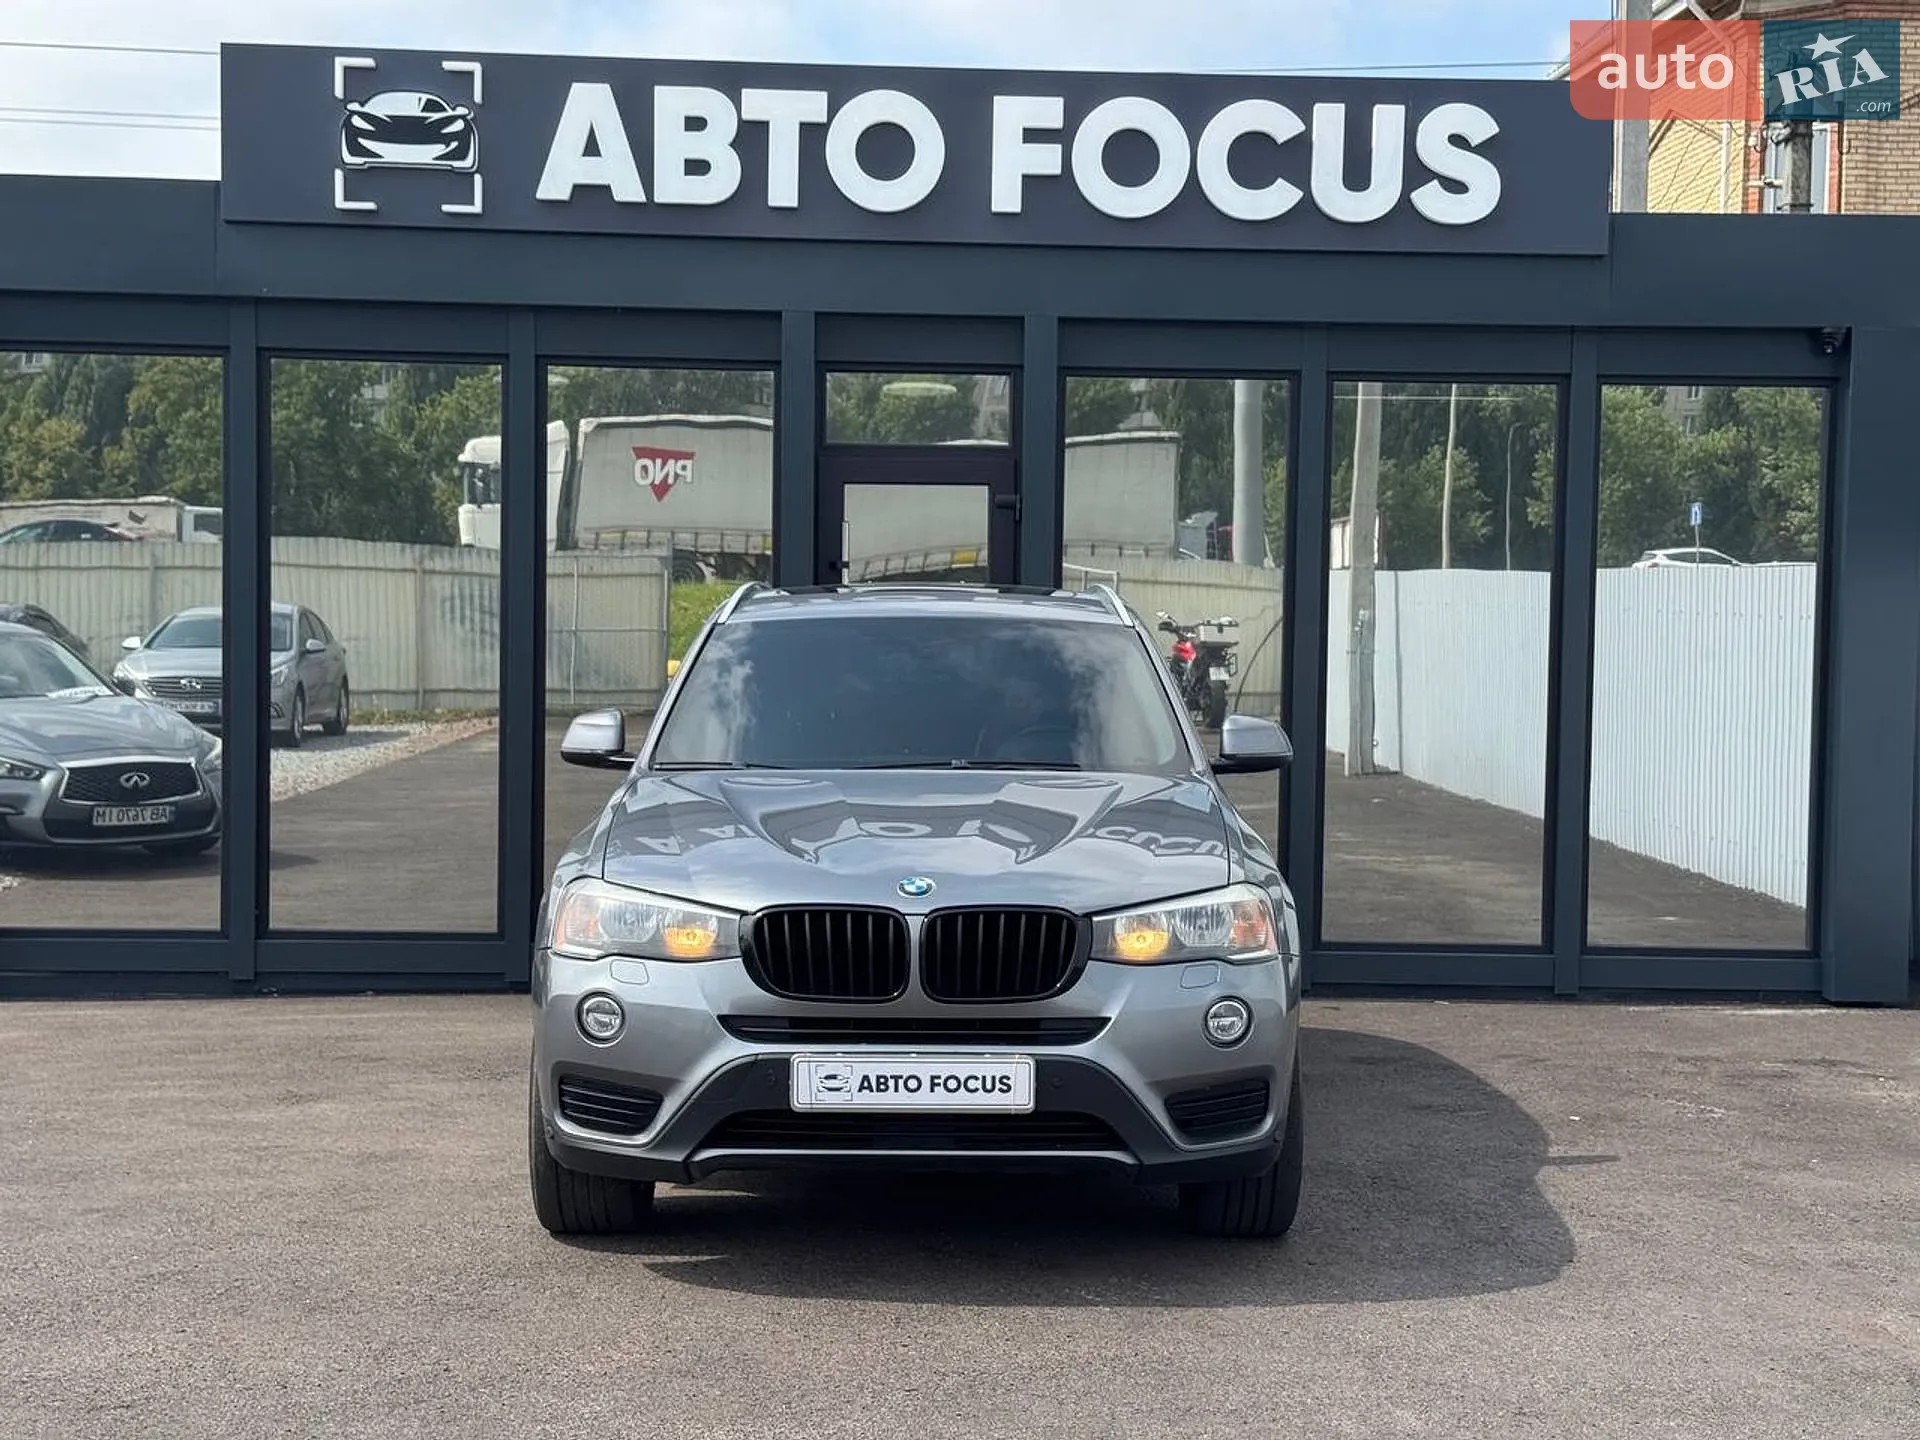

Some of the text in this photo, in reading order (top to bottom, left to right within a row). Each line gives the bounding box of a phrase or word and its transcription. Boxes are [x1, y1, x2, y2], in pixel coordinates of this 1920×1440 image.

[535, 82, 1503, 227] АВТО FOCUS
[857, 1074, 1012, 1094] АВТО FOCUS
